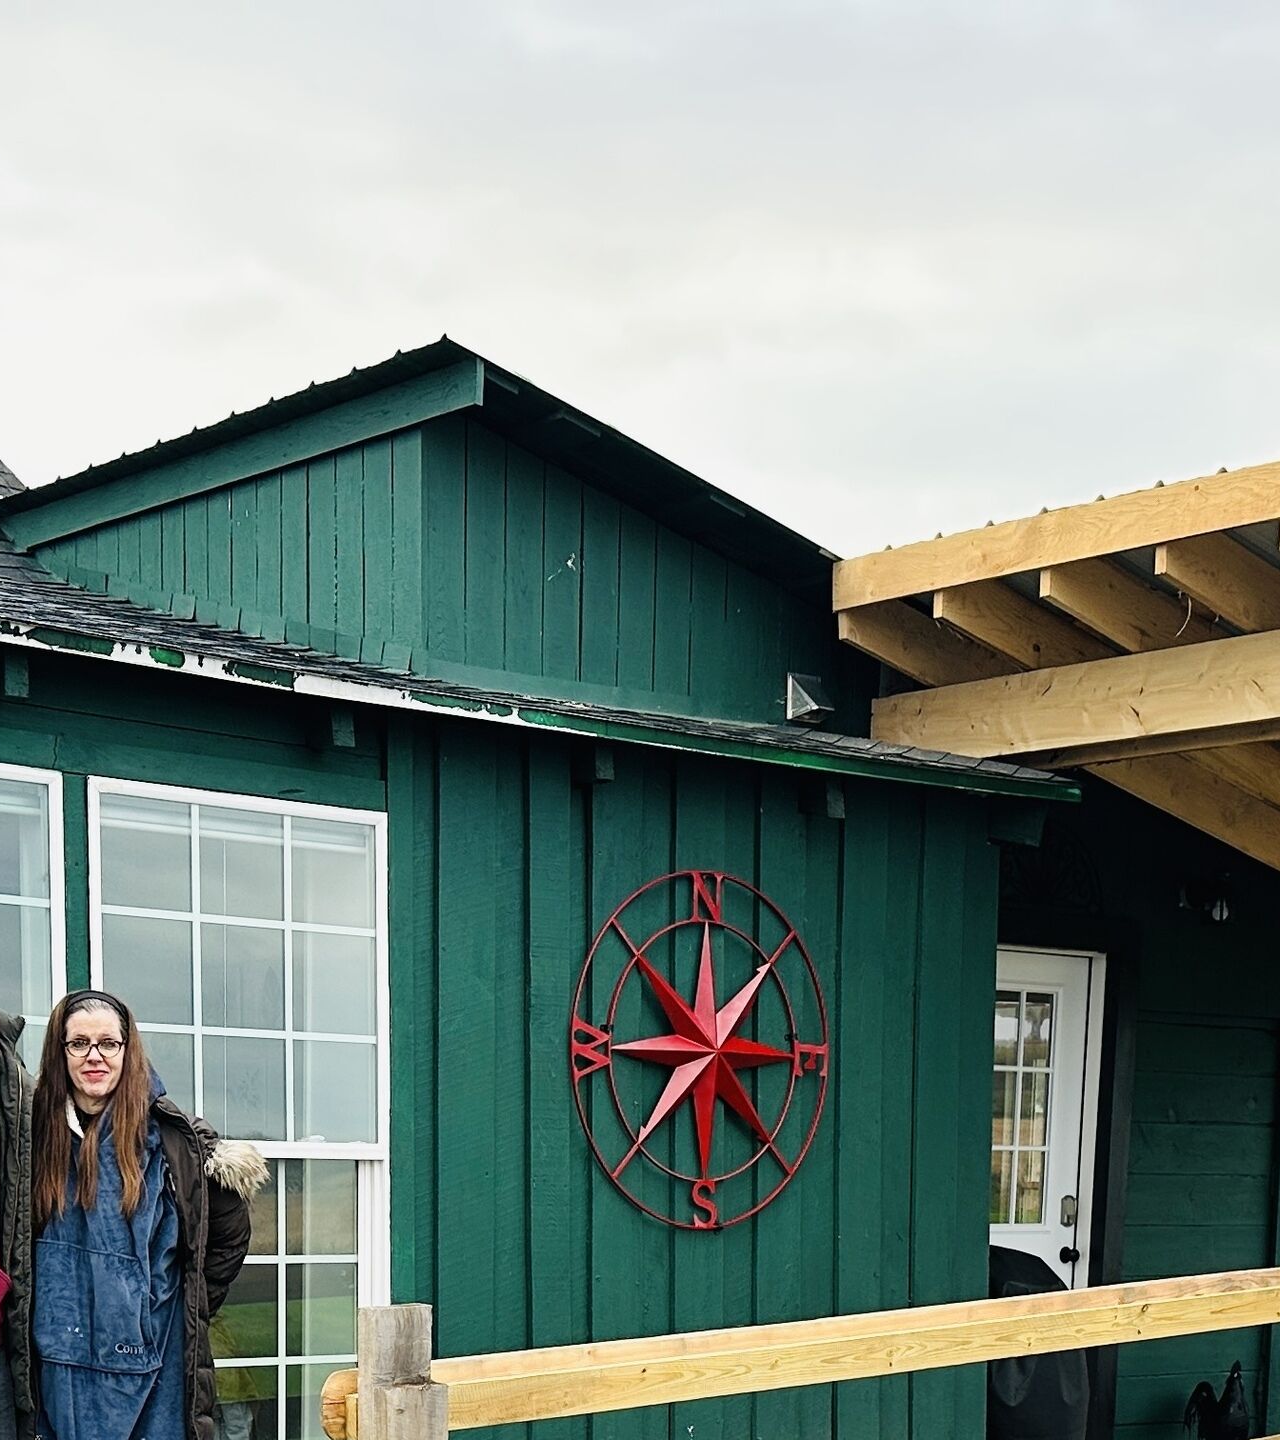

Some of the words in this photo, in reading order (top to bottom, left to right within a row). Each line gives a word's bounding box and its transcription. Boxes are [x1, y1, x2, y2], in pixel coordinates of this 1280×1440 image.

[690, 871, 724, 922] N
[572, 1016, 611, 1081] W
[794, 1041, 829, 1077] E
[692, 1180, 719, 1229] S
